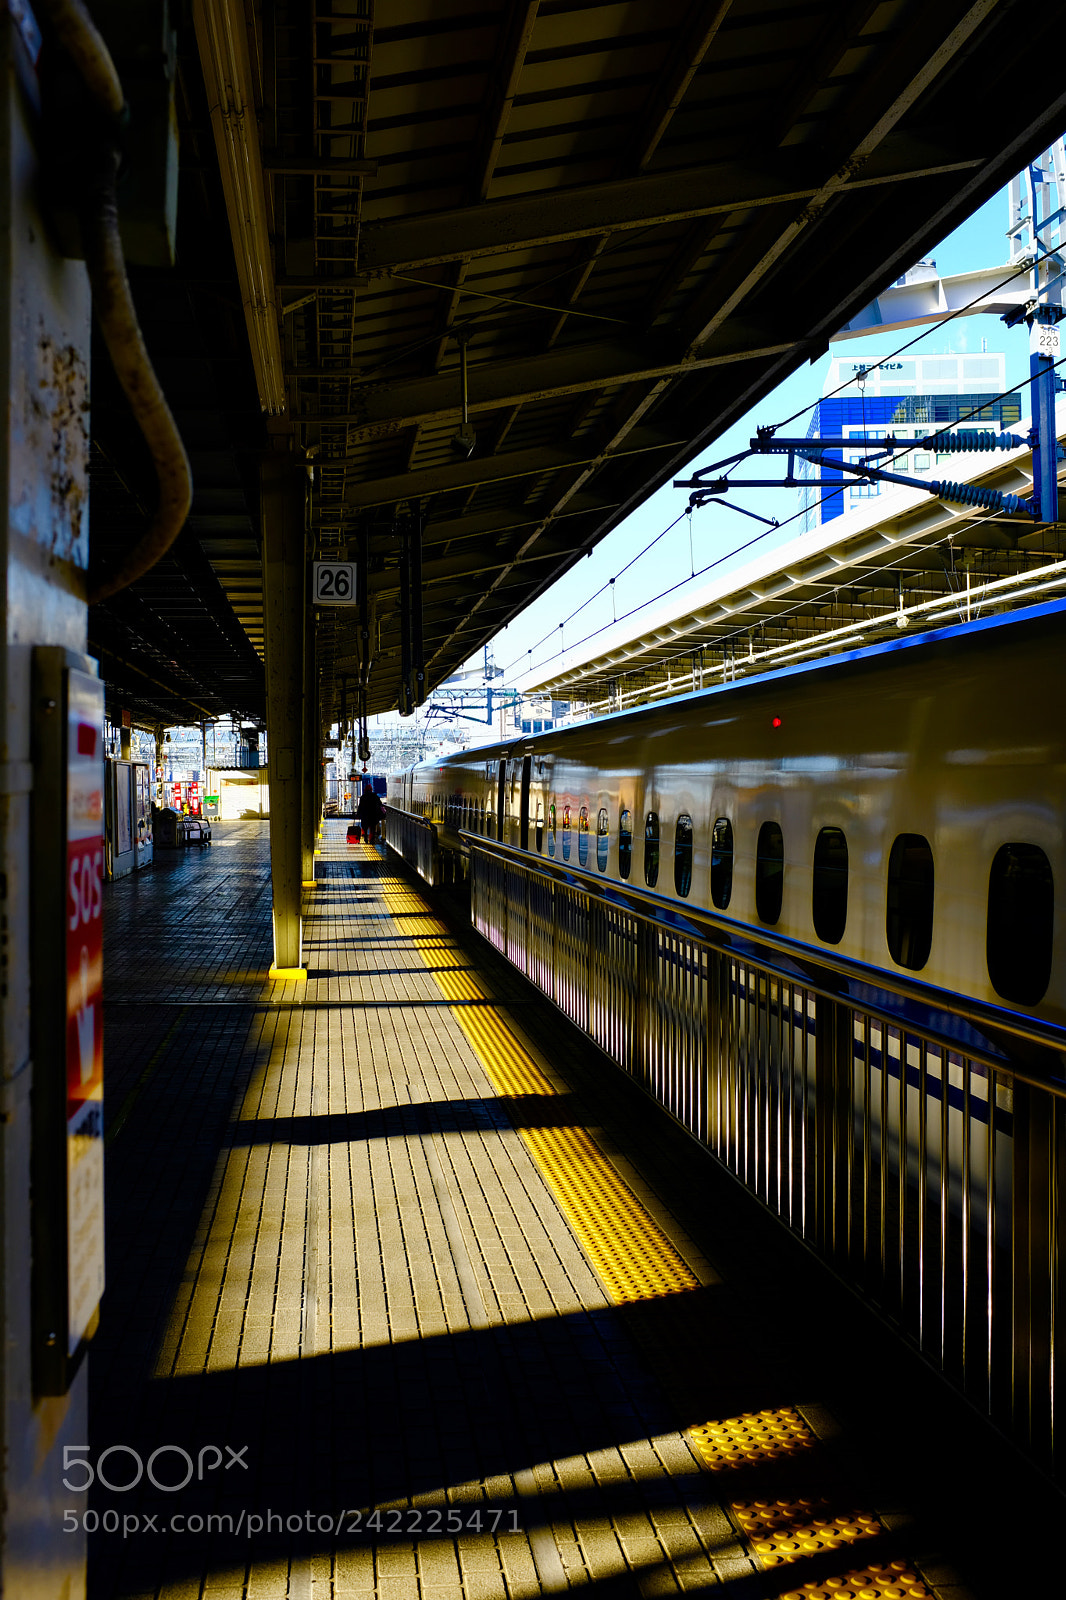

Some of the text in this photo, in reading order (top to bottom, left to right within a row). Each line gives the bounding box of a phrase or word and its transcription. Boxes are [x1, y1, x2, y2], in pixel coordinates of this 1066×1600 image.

[1039, 335, 1059, 347] 223
[319, 569, 350, 597] 26
[417, 672, 424, 681] 3
[70, 852, 101, 931] SOS
